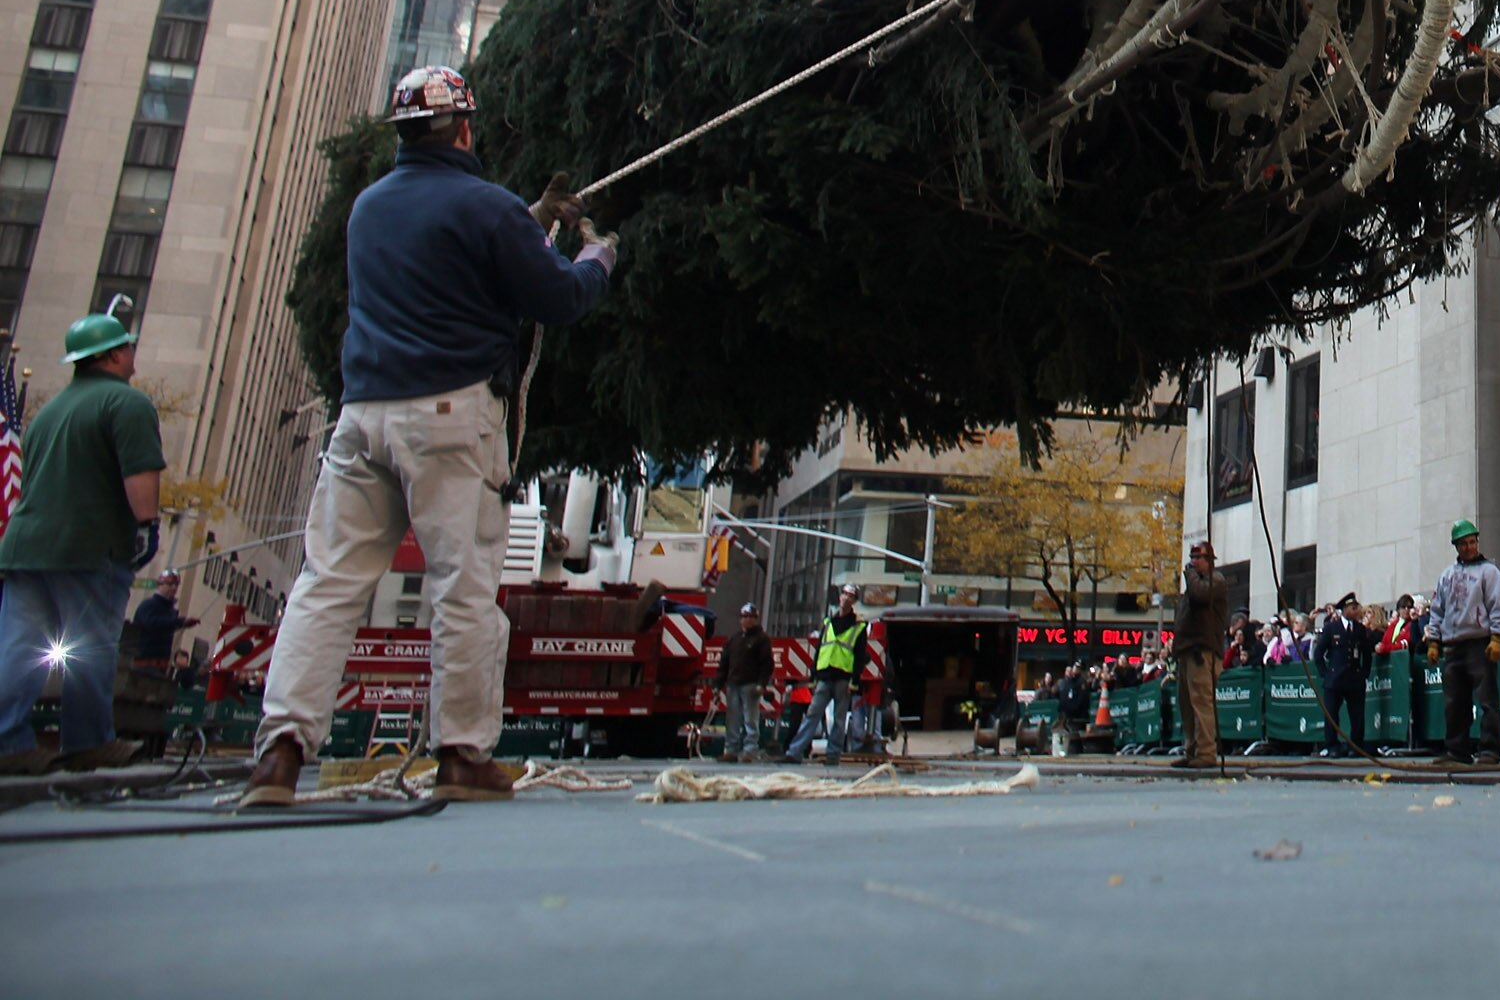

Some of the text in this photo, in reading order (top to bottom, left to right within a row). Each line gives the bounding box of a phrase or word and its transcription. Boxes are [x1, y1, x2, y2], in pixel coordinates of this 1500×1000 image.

[1045, 628, 1088, 644] YOK
[1103, 630, 1142, 645] BILLY
[532, 640, 634, 652] BAY CRANE
[706, 652, 722, 662] BA
[529, 691, 619, 699] WWW.BAYCRANE.COM
